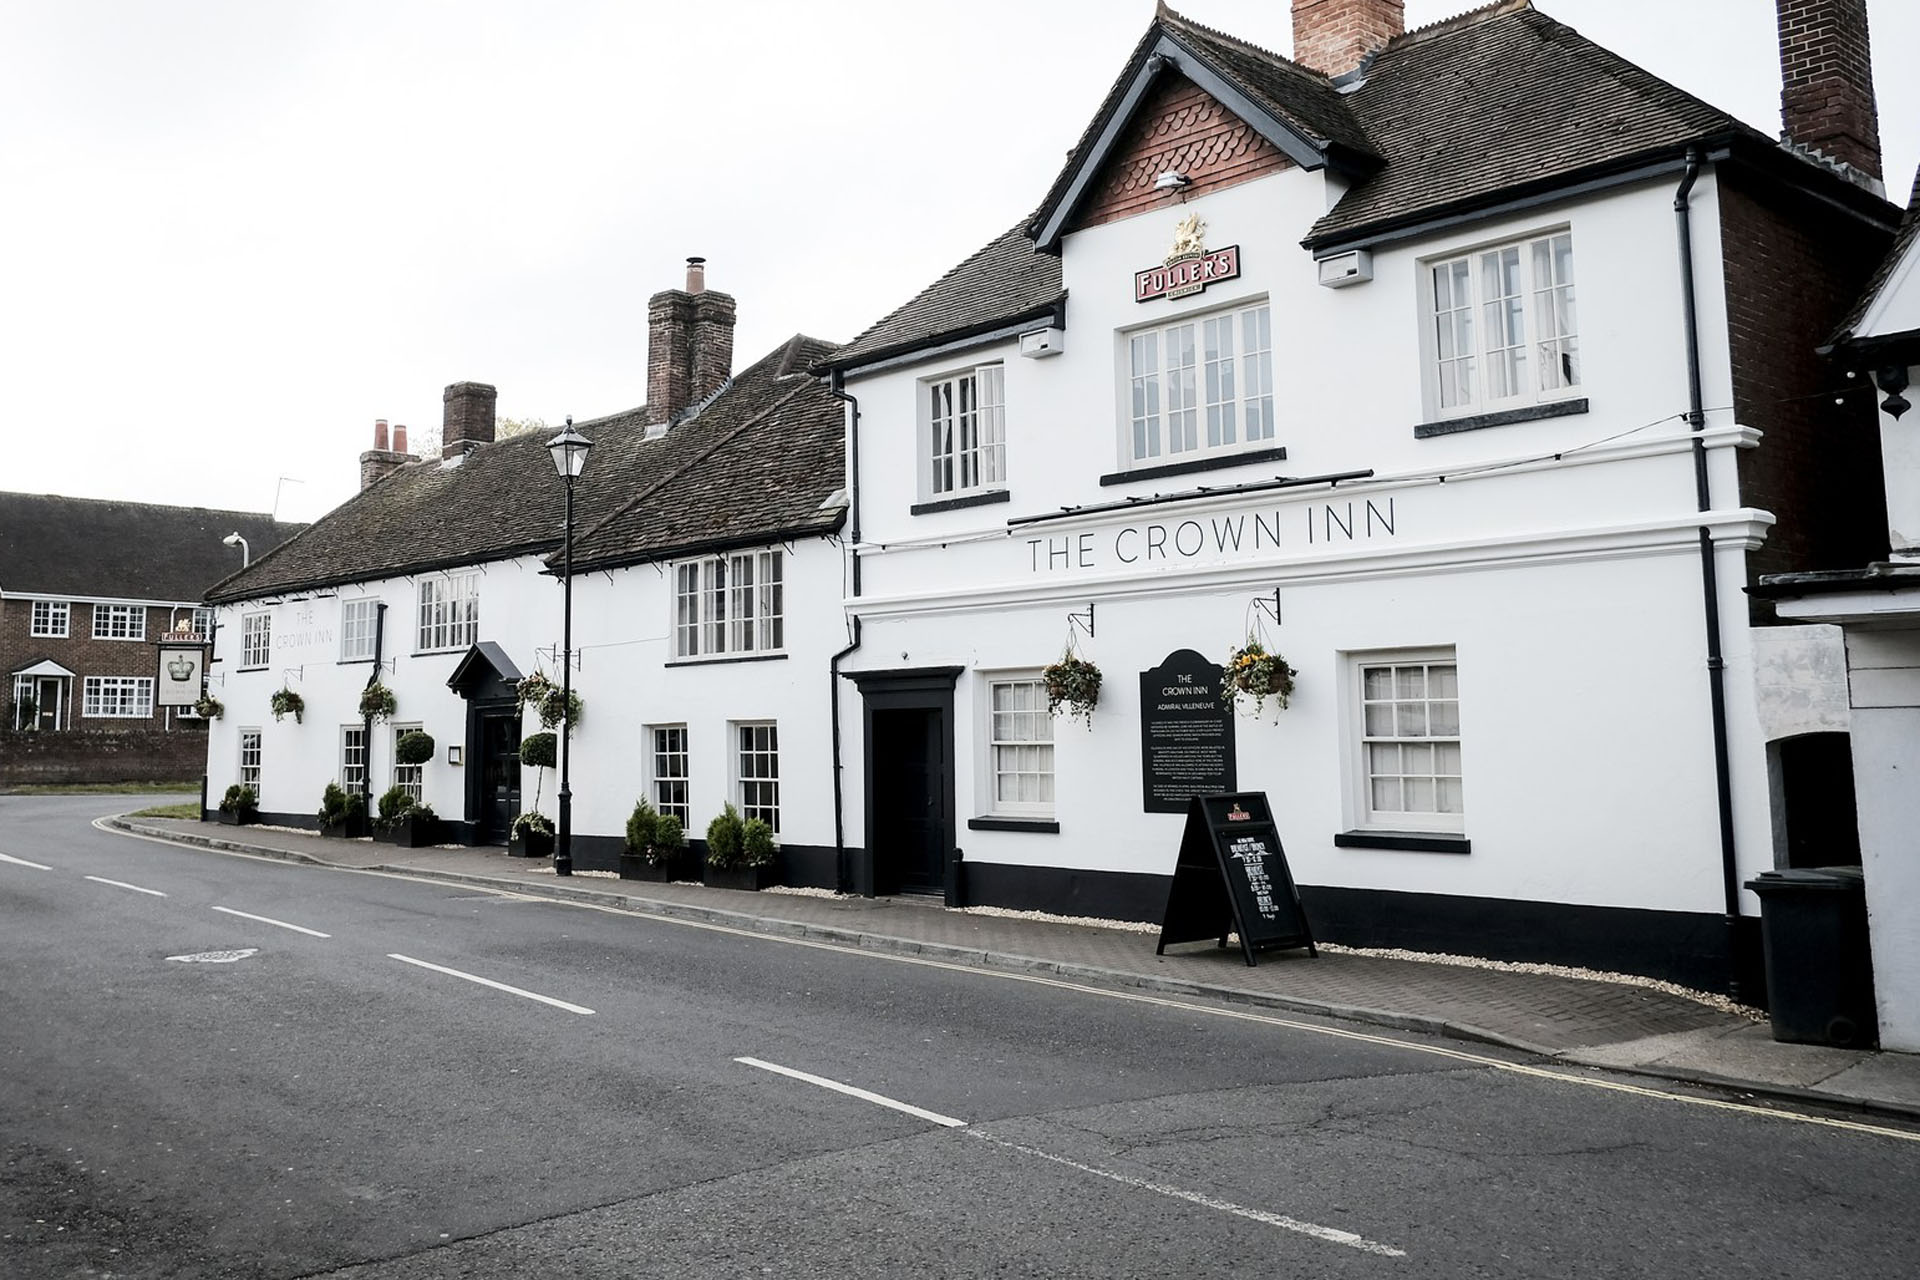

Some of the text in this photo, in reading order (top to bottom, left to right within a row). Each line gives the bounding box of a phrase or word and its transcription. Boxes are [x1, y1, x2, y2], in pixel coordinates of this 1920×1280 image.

[1140, 254, 1230, 295] FULLER'S
[1027, 497, 1394, 572] THE CROWN INN
[296, 610, 313, 625] THE
[276, 628, 333, 650] CROWN INN
[1177, 674, 1193, 684] THE
[1162, 685, 1209, 697] CROWN INN
[1157, 702, 1182, 711] ADMIRAL
